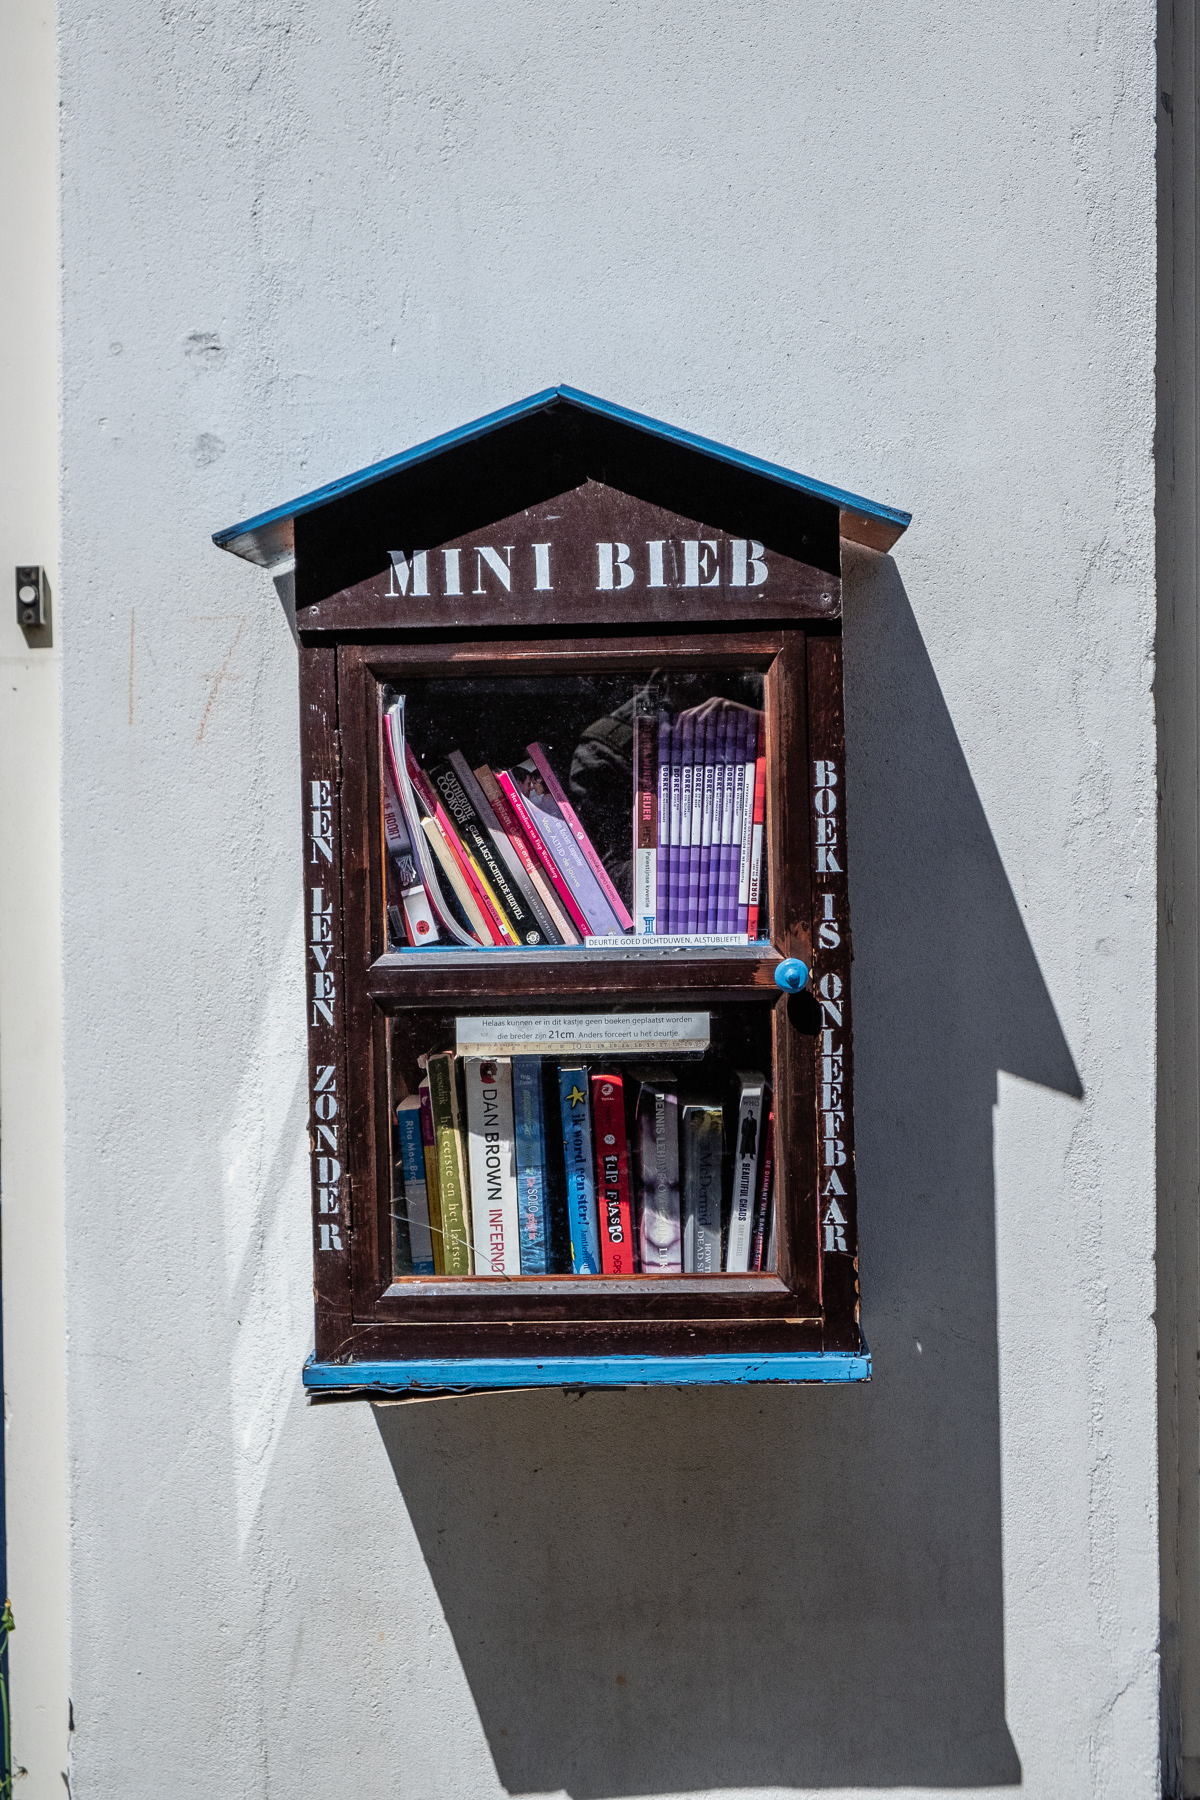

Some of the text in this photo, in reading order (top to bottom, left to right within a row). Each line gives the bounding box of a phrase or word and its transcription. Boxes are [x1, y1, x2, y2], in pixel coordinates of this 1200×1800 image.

[385, 539, 769, 597] MINI BIEB
[434, 774, 468, 824] COOKSON
[443, 769, 476, 820] CATHERINE
[385, 812, 401, 840] HOORT
[467, 823, 485, 847] GELUK
[509, 791, 558, 880] Het dierenfeest van Fiep Westendorp
[540, 816, 553, 834] Voor
[478, 844, 493, 862] LIGT
[561, 856, 571, 867] de
[566, 843, 584, 868] Carpenter
[486, 858, 506, 886] ACHTER
[565, 866, 582, 889] jouwe
[499, 883, 511, 895] DE
[504, 892, 525, 921] HEUVELS
[643, 937, 692, 945] DICHTDUWEN,
[309, 780, 344, 1251] EEN LEVEN ZONDER
[814, 760, 848, 1252] BOEK IS ONLEEFBAAR
[563, 1018, 584, 1027] kastje
[632, 1016, 664, 1026] geplaatst
[534, 1032, 547, 1040] zijn
[548, 1030, 576, 1039] 21cm.
[440, 1116, 450, 1132] het
[655, 1094, 665, 1135] DENNIS
[405, 1120, 415, 1140] Rita
[444, 1141, 454, 1176] eerste
[572, 1113, 590, 1226] ik word een ster!
[766, 1160, 771, 1169] DE
[447, 1182, 455, 1197] en
[483, 1089, 505, 1273] DAN BROWN INFERNO
[700, 1152, 712, 1226] McDermid
[762, 1170, 770, 1200] DIAMANT
[528, 1188, 539, 1213] SOLO
[739, 1197, 748, 1222] CHAOS
[449, 1203, 459, 1226] het
[450, 1232, 461, 1269] laatste
[578, 1228, 590, 1254] Jantien
[659, 1246, 668, 1270] LIJK
